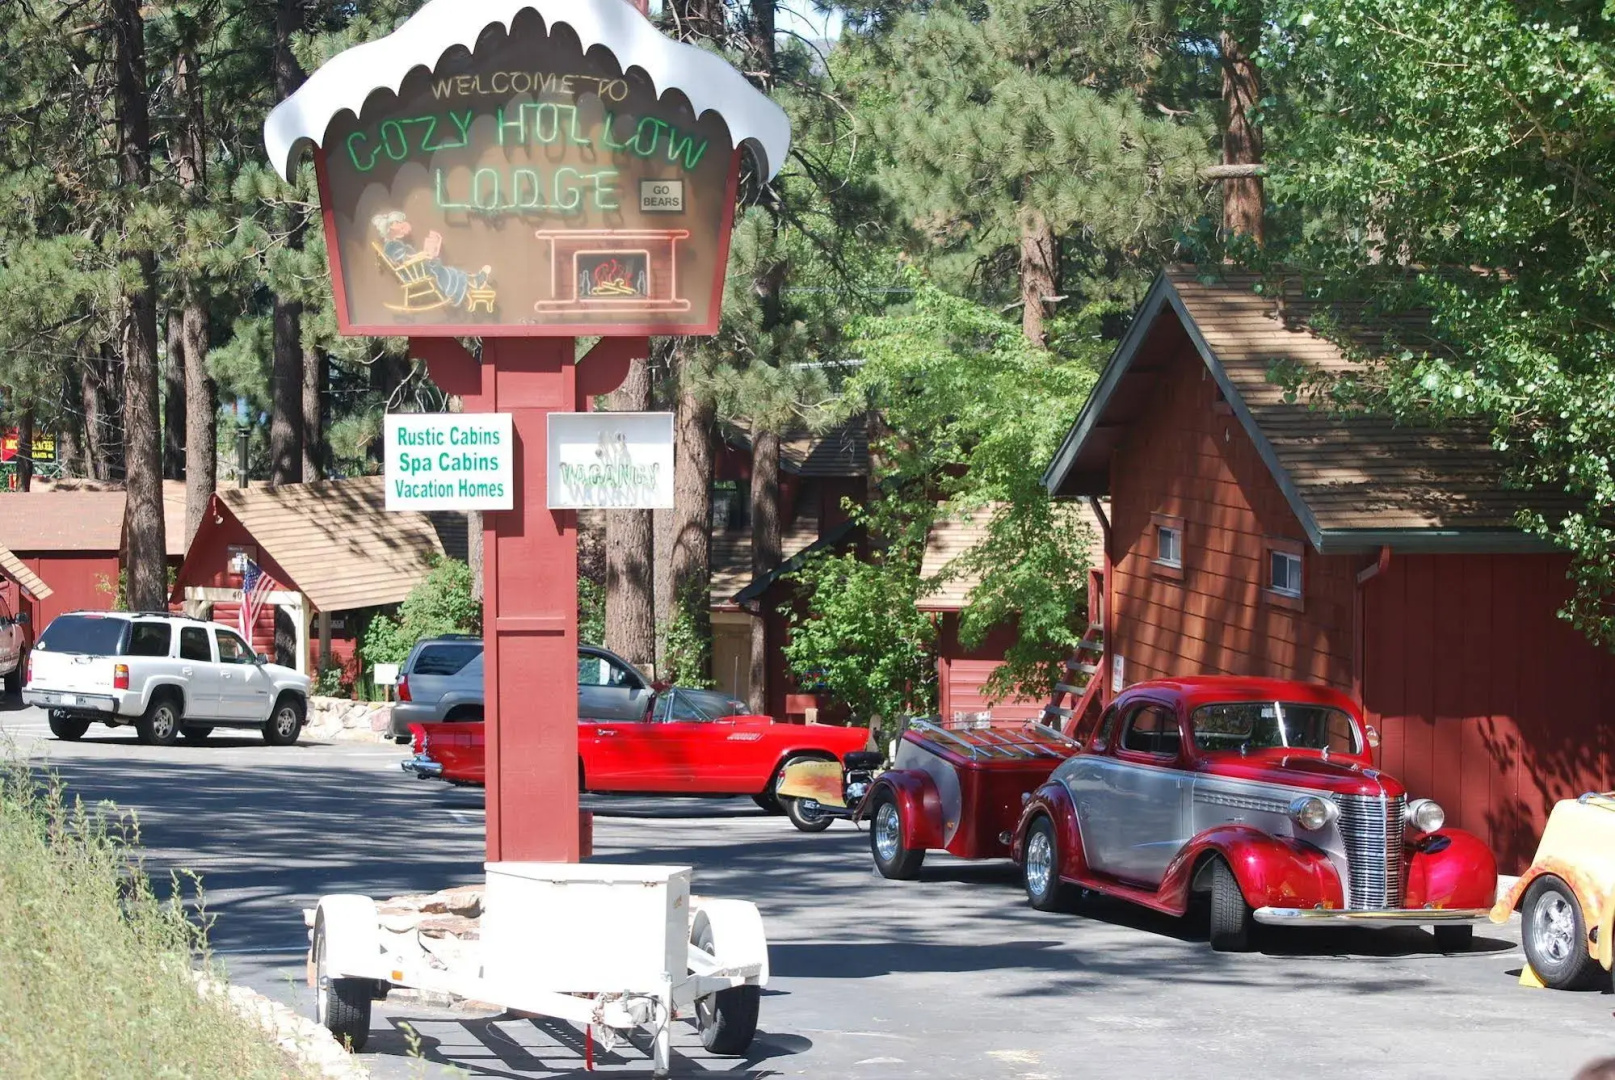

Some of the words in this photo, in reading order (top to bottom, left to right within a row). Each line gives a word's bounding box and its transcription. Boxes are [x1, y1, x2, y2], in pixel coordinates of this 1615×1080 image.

[432, 71, 575, 99] WELCOME
[591, 74, 628, 101] TO
[347, 110, 472, 171] COZY
[498, 103, 708, 169] HOLLOW
[435, 167, 618, 209] LODGE
[653, 185, 670, 195] GO
[643, 197, 680, 207] BEARS
[398, 426, 444, 446] Rustic
[450, 426, 500, 445] Cabins
[399, 452, 432, 476] Spa
[439, 452, 499, 471] Cabins
[559, 462, 660, 488] VACANCY
[395, 479, 454, 498] Vacation
[458, 479, 504, 498] Homes
